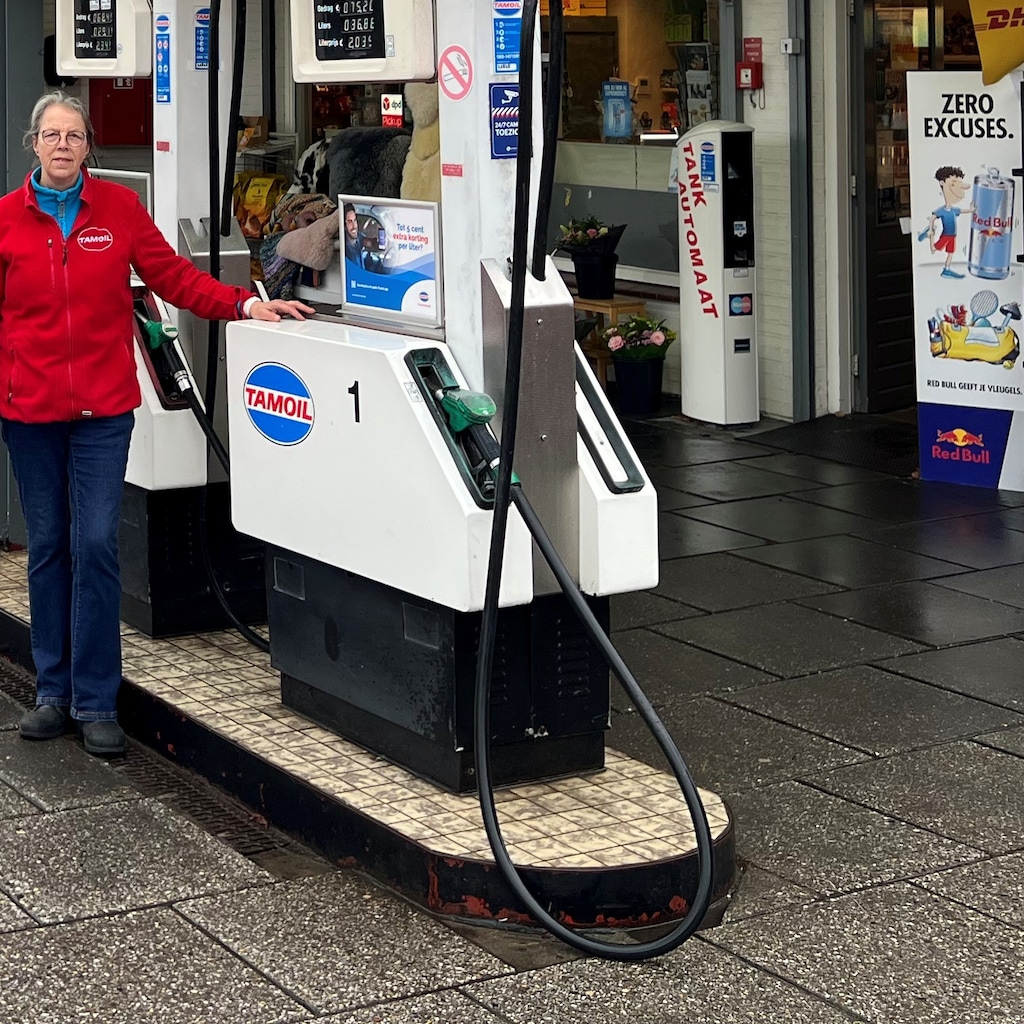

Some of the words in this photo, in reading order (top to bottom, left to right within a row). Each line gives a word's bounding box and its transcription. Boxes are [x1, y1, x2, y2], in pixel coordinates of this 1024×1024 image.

[391, 99, 402, 109] dpd
[941, 94, 994, 114] ZERO
[382, 117, 402, 127] Pickup
[924, 117, 1014, 139] EXCUSES.
[683, 141, 707, 207] TANK
[397, 223, 406, 231] Tot
[411, 225, 424, 233] cent
[973, 213, 991, 227] Red
[993, 217, 1012, 228] Bull
[78, 234, 112, 244] TAMOIL
[408, 234, 429, 244] korting
[398, 243, 408, 251] per
[678, 181, 719, 318] AUTOMAAT
[927, 379, 940, 387] RED
[941, 381, 956, 389] BULL
[958, 382, 977, 391] GEEFT
[979, 384, 986, 392] JE
[987, 384, 1023, 395] VLEUGELS.
[245, 386, 314, 423] TAMOIL
[347, 380, 361, 423] 1
[932, 445, 960, 461] Red
[961, 448, 990, 464] Bull
